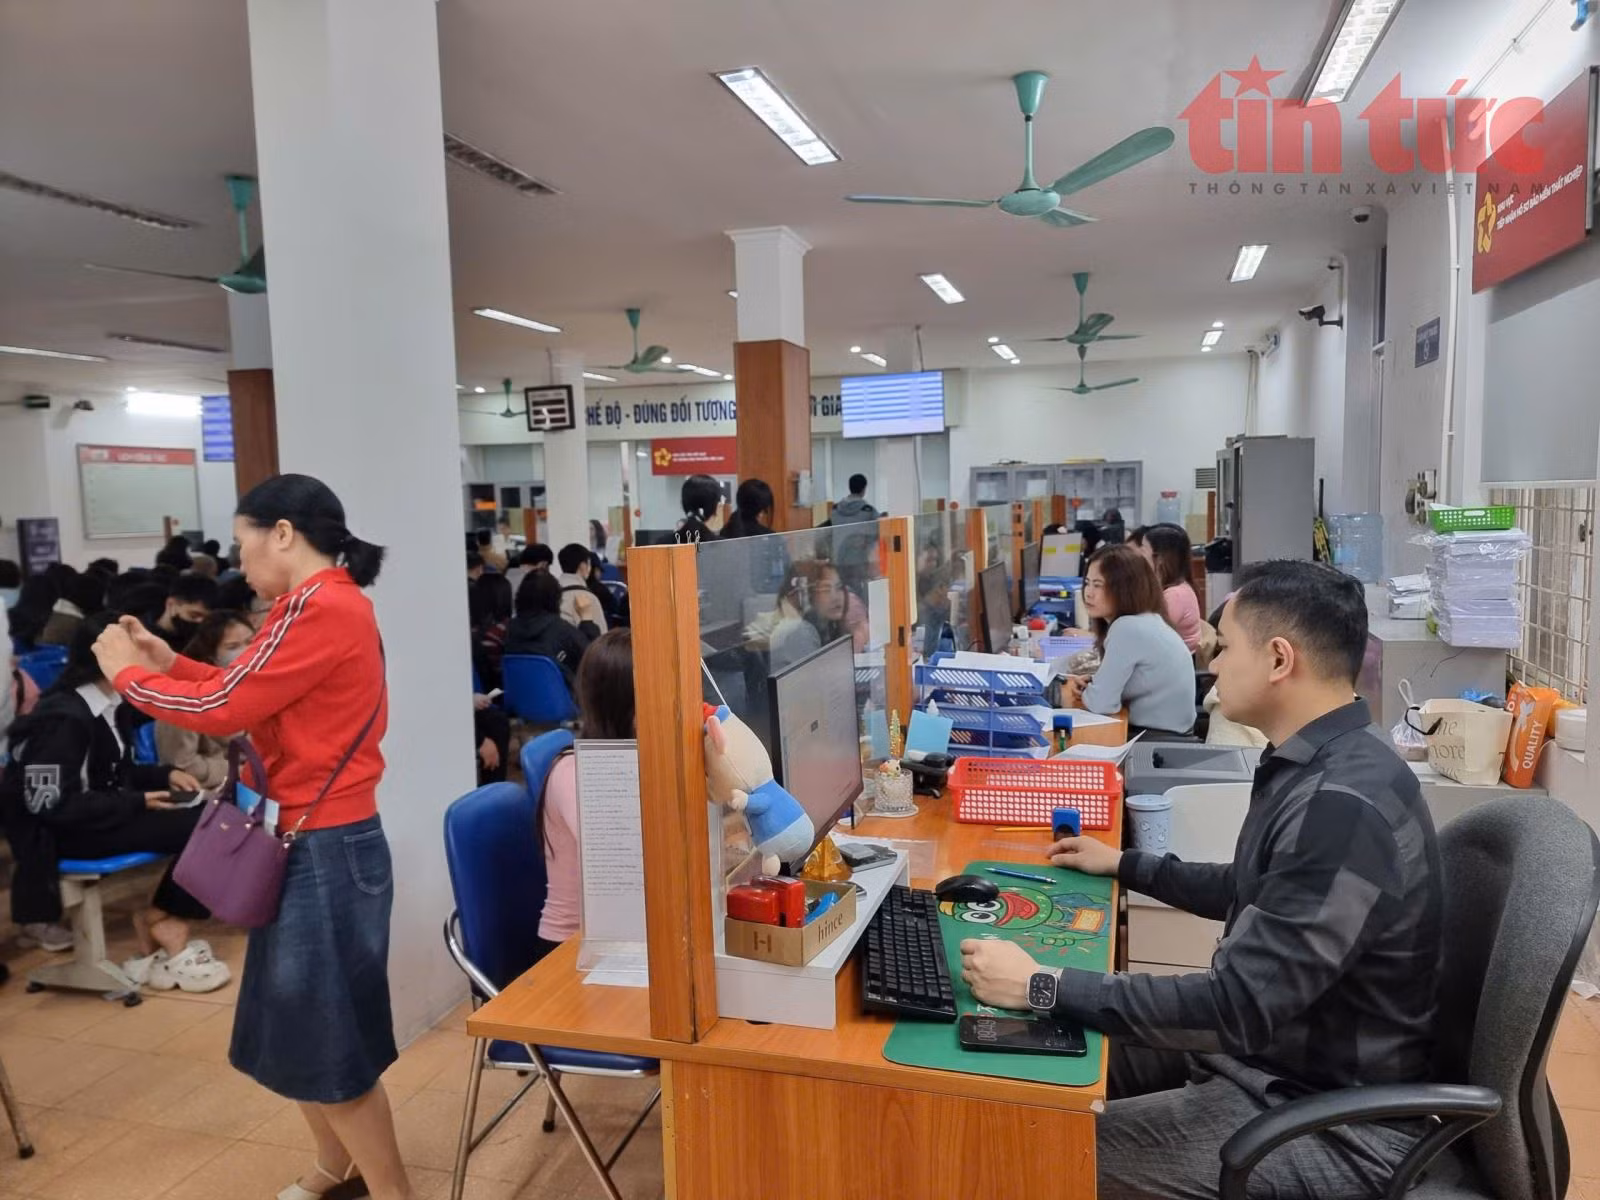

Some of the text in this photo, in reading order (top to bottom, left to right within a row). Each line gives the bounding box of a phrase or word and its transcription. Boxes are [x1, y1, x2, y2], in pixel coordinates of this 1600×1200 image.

[585, 398, 603, 426] HẾ
[1522, 720, 1543, 769] QUALITY
[817, 913, 843, 944] hince
